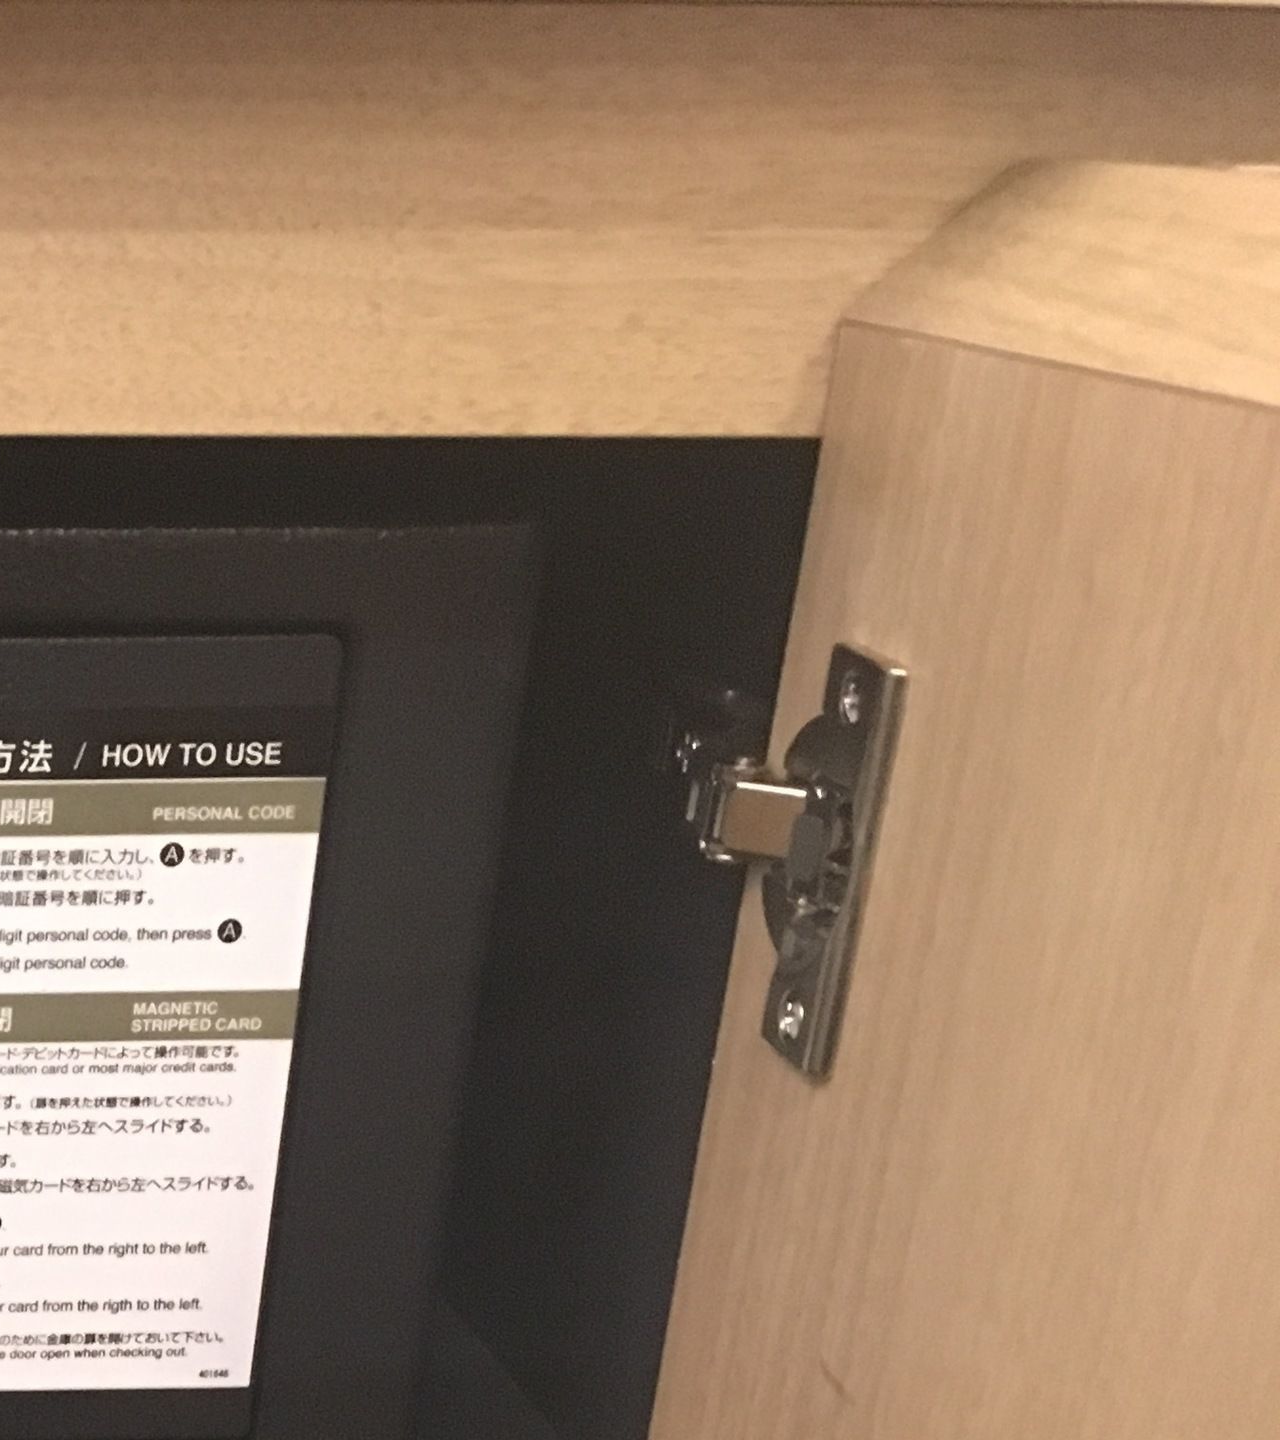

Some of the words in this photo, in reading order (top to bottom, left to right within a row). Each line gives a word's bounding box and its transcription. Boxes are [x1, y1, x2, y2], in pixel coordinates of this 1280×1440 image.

[73, 740, 87, 770] /
[101, 742, 172, 767] HOW
[178, 742, 217, 766] TO
[224, 741, 283, 766] USE
[152, 806, 243, 821] PERSONAL
[247, 804, 296, 820] CODE
[27, 928, 89, 946] personal
[93, 928, 132, 943] code,
[137, 928, 169, 941] then
[172, 929, 212, 943] press
[24, 956, 87, 973] personal
[90, 956, 129, 969] code.
[133, 1001, 219, 1016] MAGNETIC
[131, 1017, 212, 1033] STRIPPED
[215, 1016, 263, 1031] CARD
[41, 1063, 69, 1075] card
[72, 1064, 85, 1074] or
[88, 1063, 119, 1074] most
[122, 1062, 158, 1076] major
[161, 1062, 196, 1073] credit
[199, 1061, 237, 1073] cards.
[13, 1243, 44, 1257] card
[47, 1242, 79, 1256] from
[82, 1242, 104, 1255] the
[108, 1242, 139, 1258] right
[142, 1243, 156, 1255] to
[159, 1242, 181, 1255] the
[184, 1241, 209, 1255] left.
[8, 1300, 39, 1313] card
[42, 1299, 73, 1313] from
[77, 1299, 99, 1312] the
[102, 1298, 133, 1314] rigth
[136, 1299, 150, 1311] to
[153, 1298, 175, 1311] the
[178, 1298, 202, 1310] left.
[9, 1348, 37, 1360] door
[40, 1348, 70, 1361] open
[73, 1347, 106, 1359] when
[109, 1347, 163, 1360] checking
[165, 1347, 187, 1358] out.
